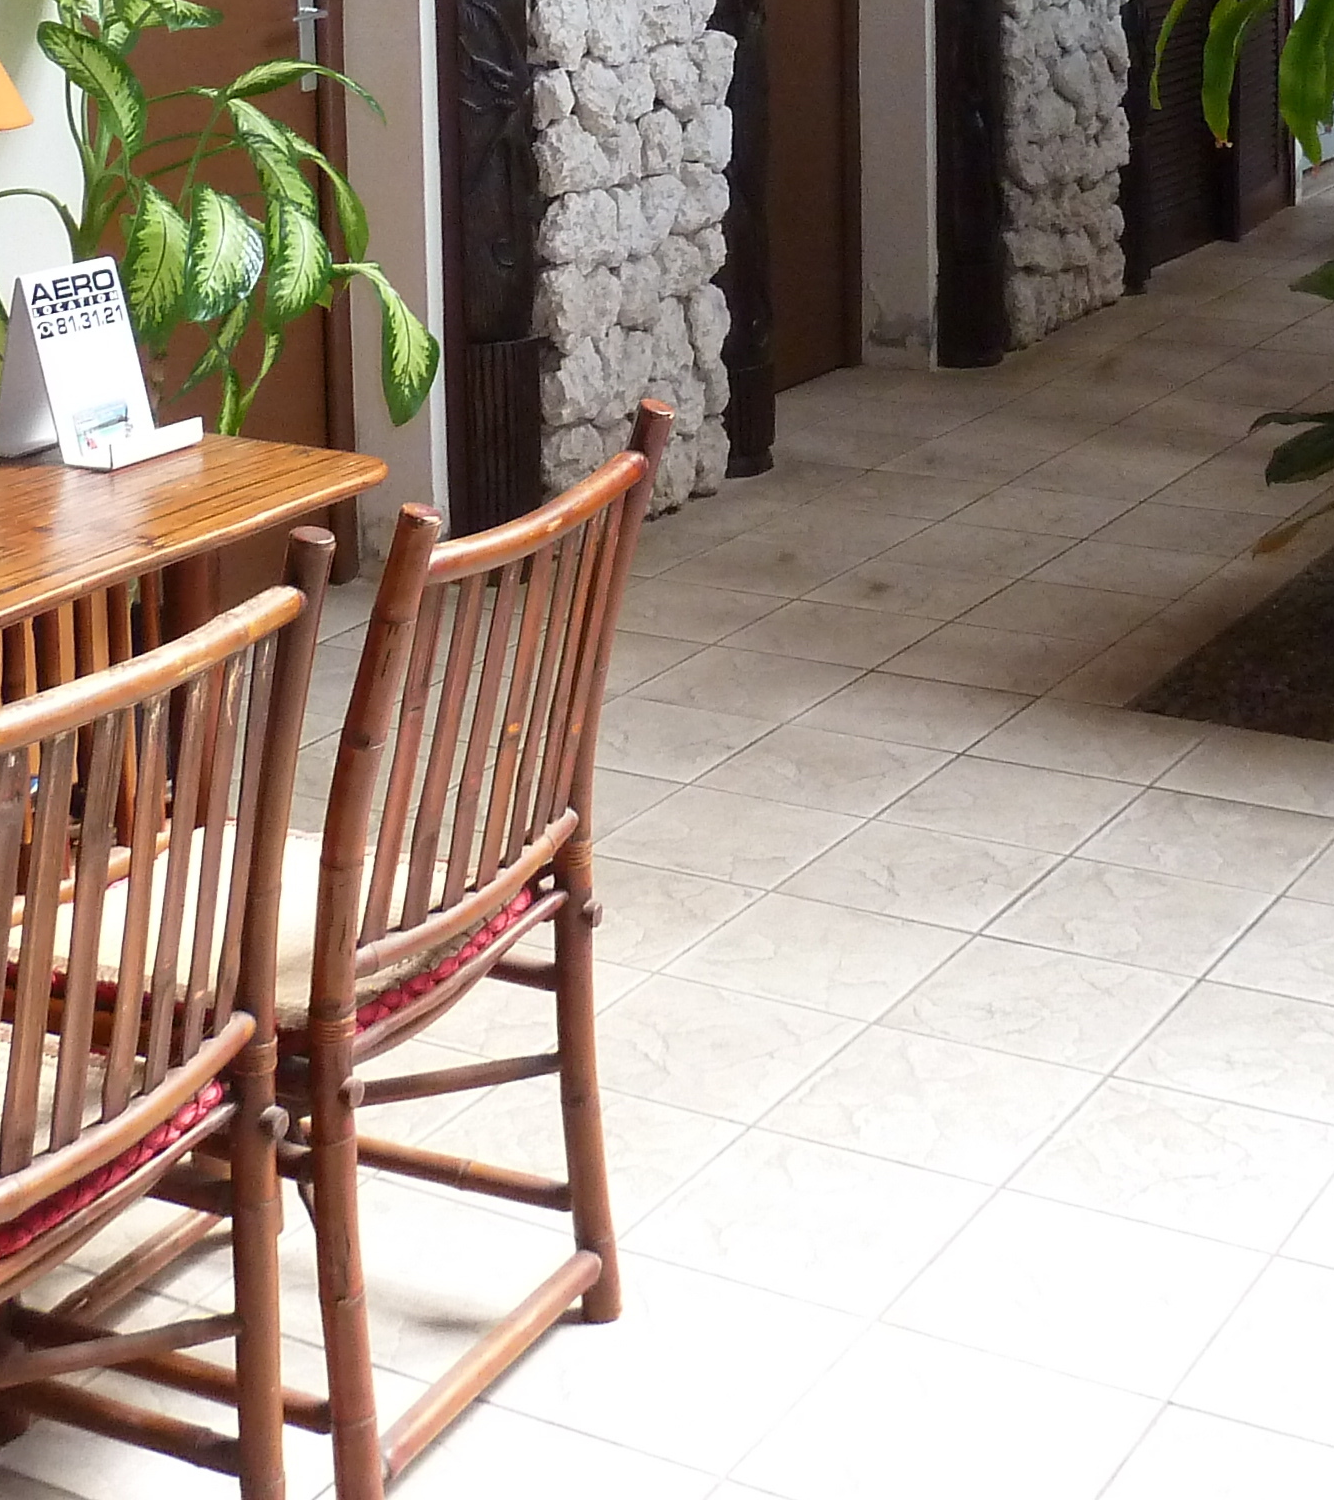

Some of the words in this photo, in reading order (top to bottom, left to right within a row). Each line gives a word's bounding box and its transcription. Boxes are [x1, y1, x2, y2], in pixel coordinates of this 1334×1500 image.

[31, 269, 115, 305] AERO
[32, 290, 119, 318] LOCATION
[56, 304, 124, 335] 81.31.21
